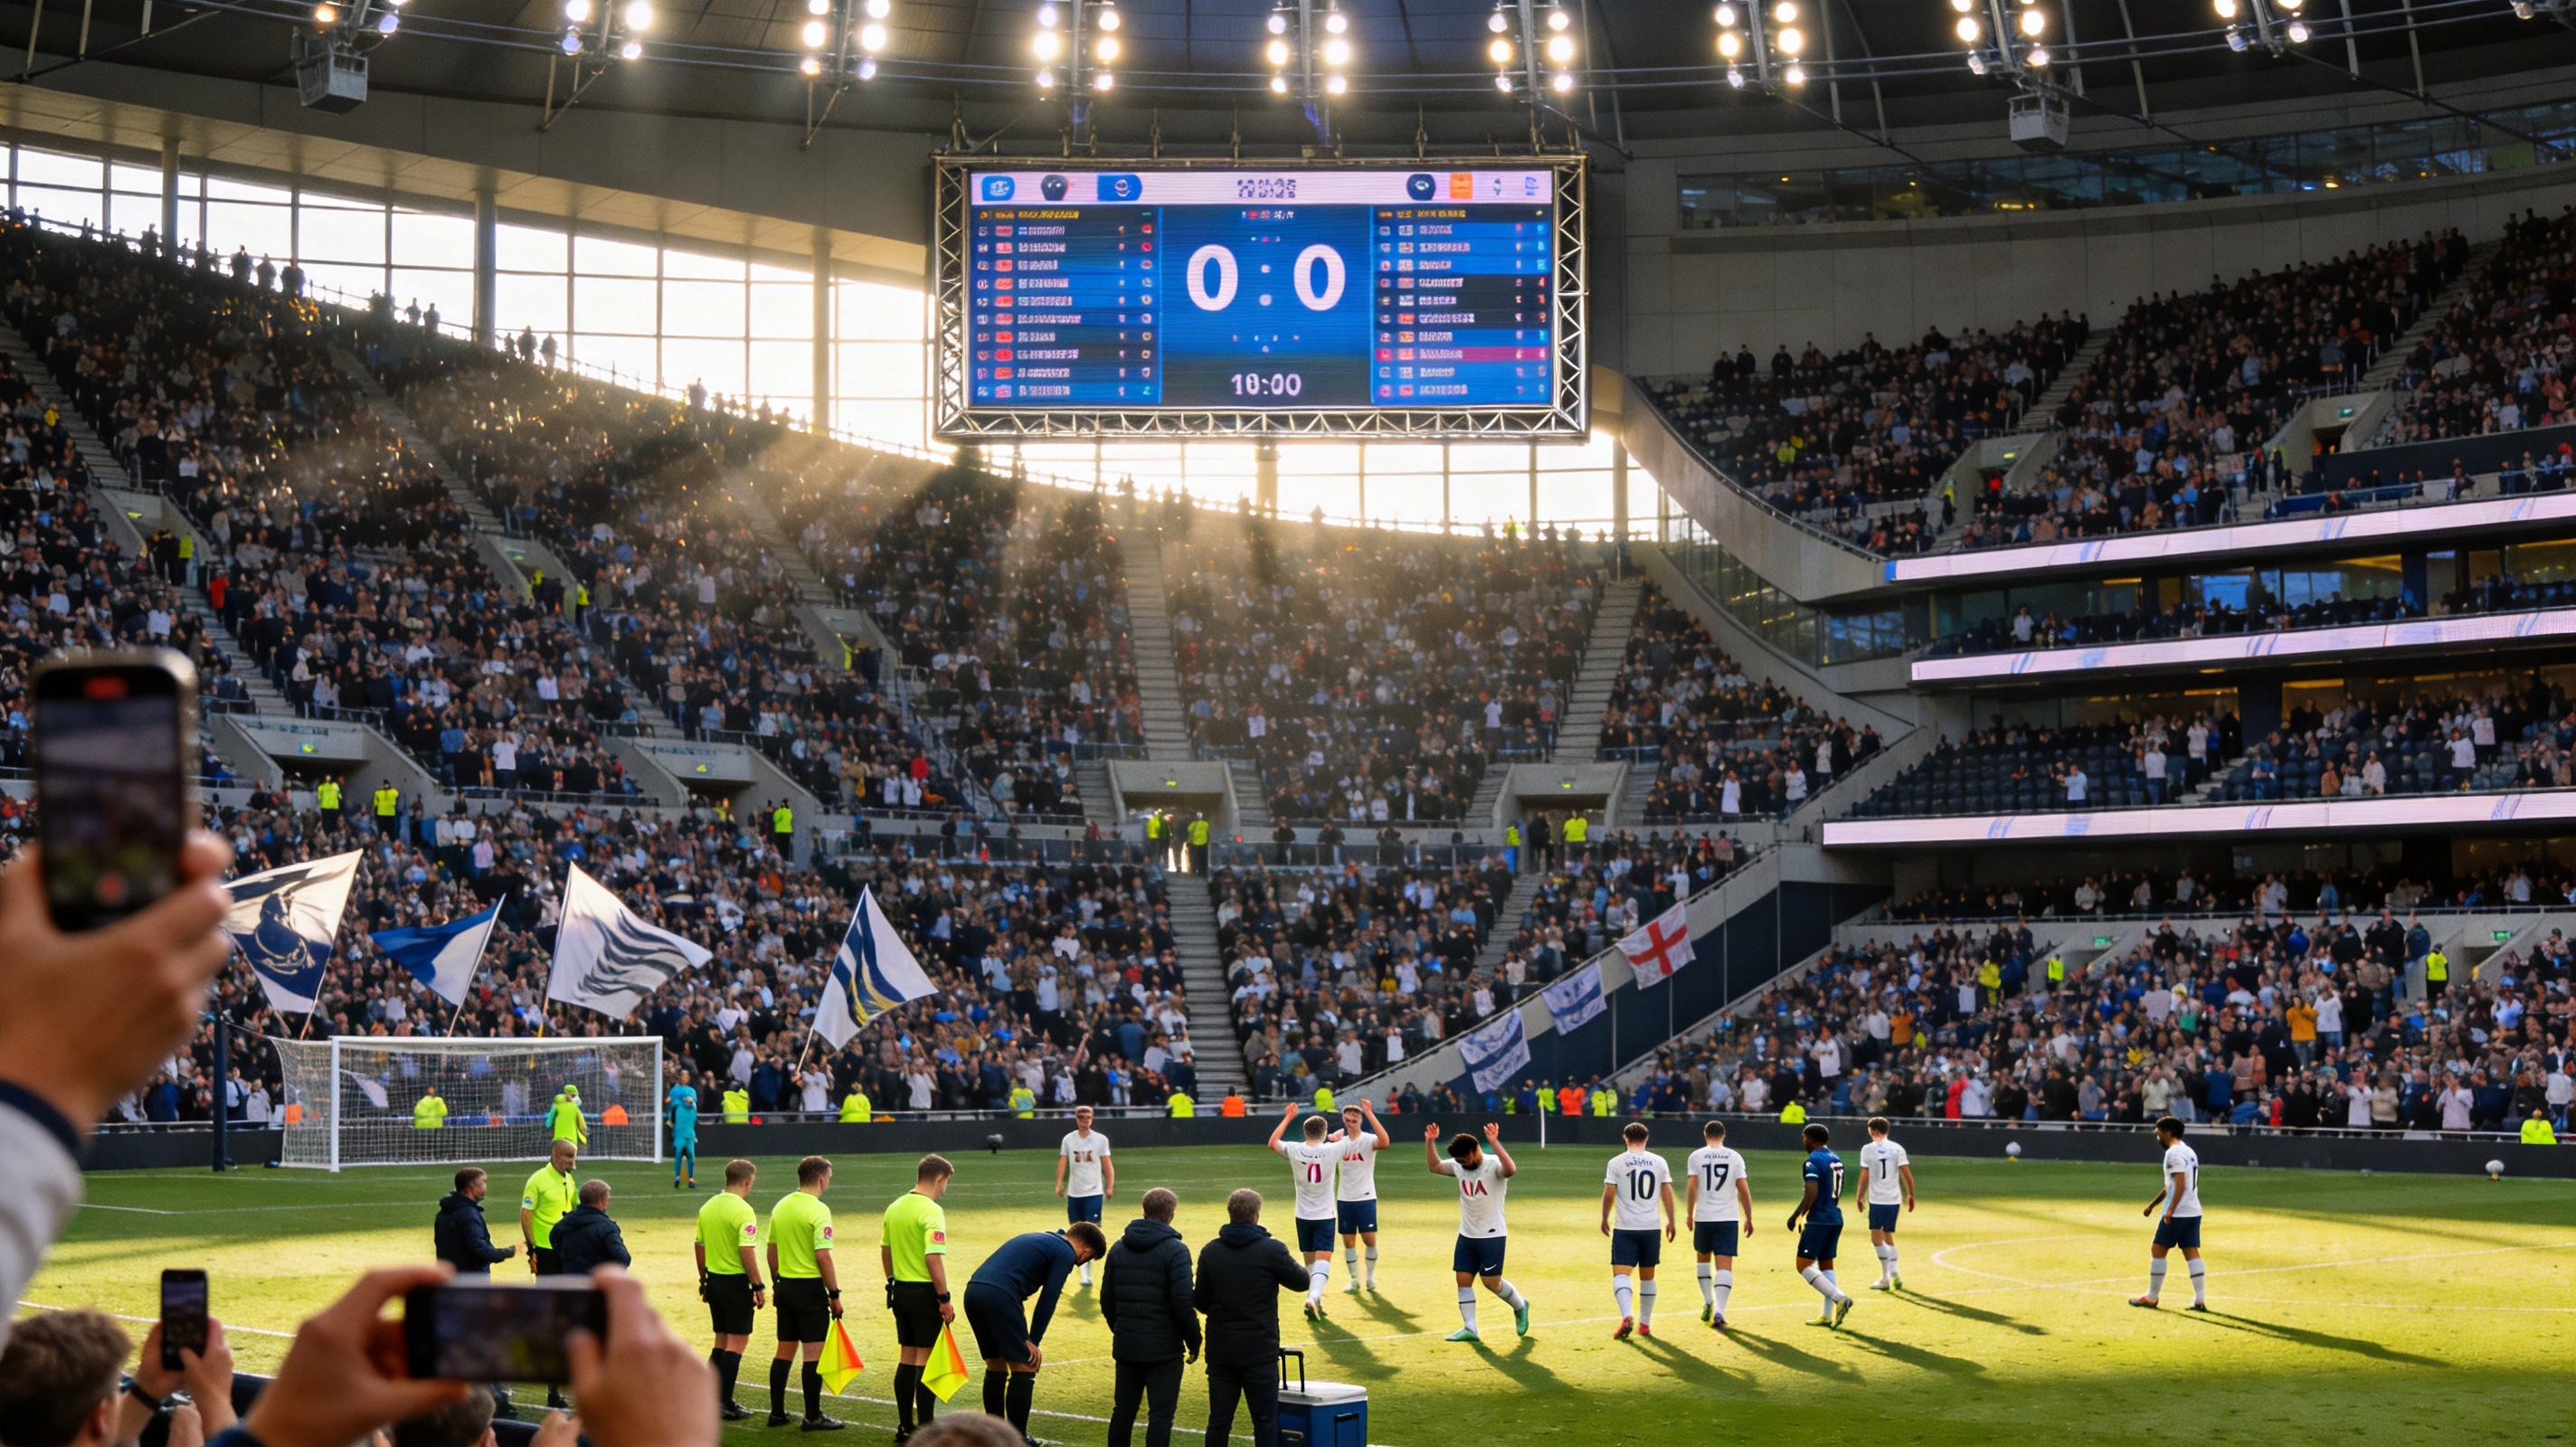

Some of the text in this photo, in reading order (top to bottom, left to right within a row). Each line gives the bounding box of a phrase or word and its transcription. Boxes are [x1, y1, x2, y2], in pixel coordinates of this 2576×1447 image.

[1186, 243, 1238, 312] 0
[1293, 243, 1346, 311] 0
[1625, 1168, 1656, 1201] 10
[1701, 1163, 1729, 1192] 19
